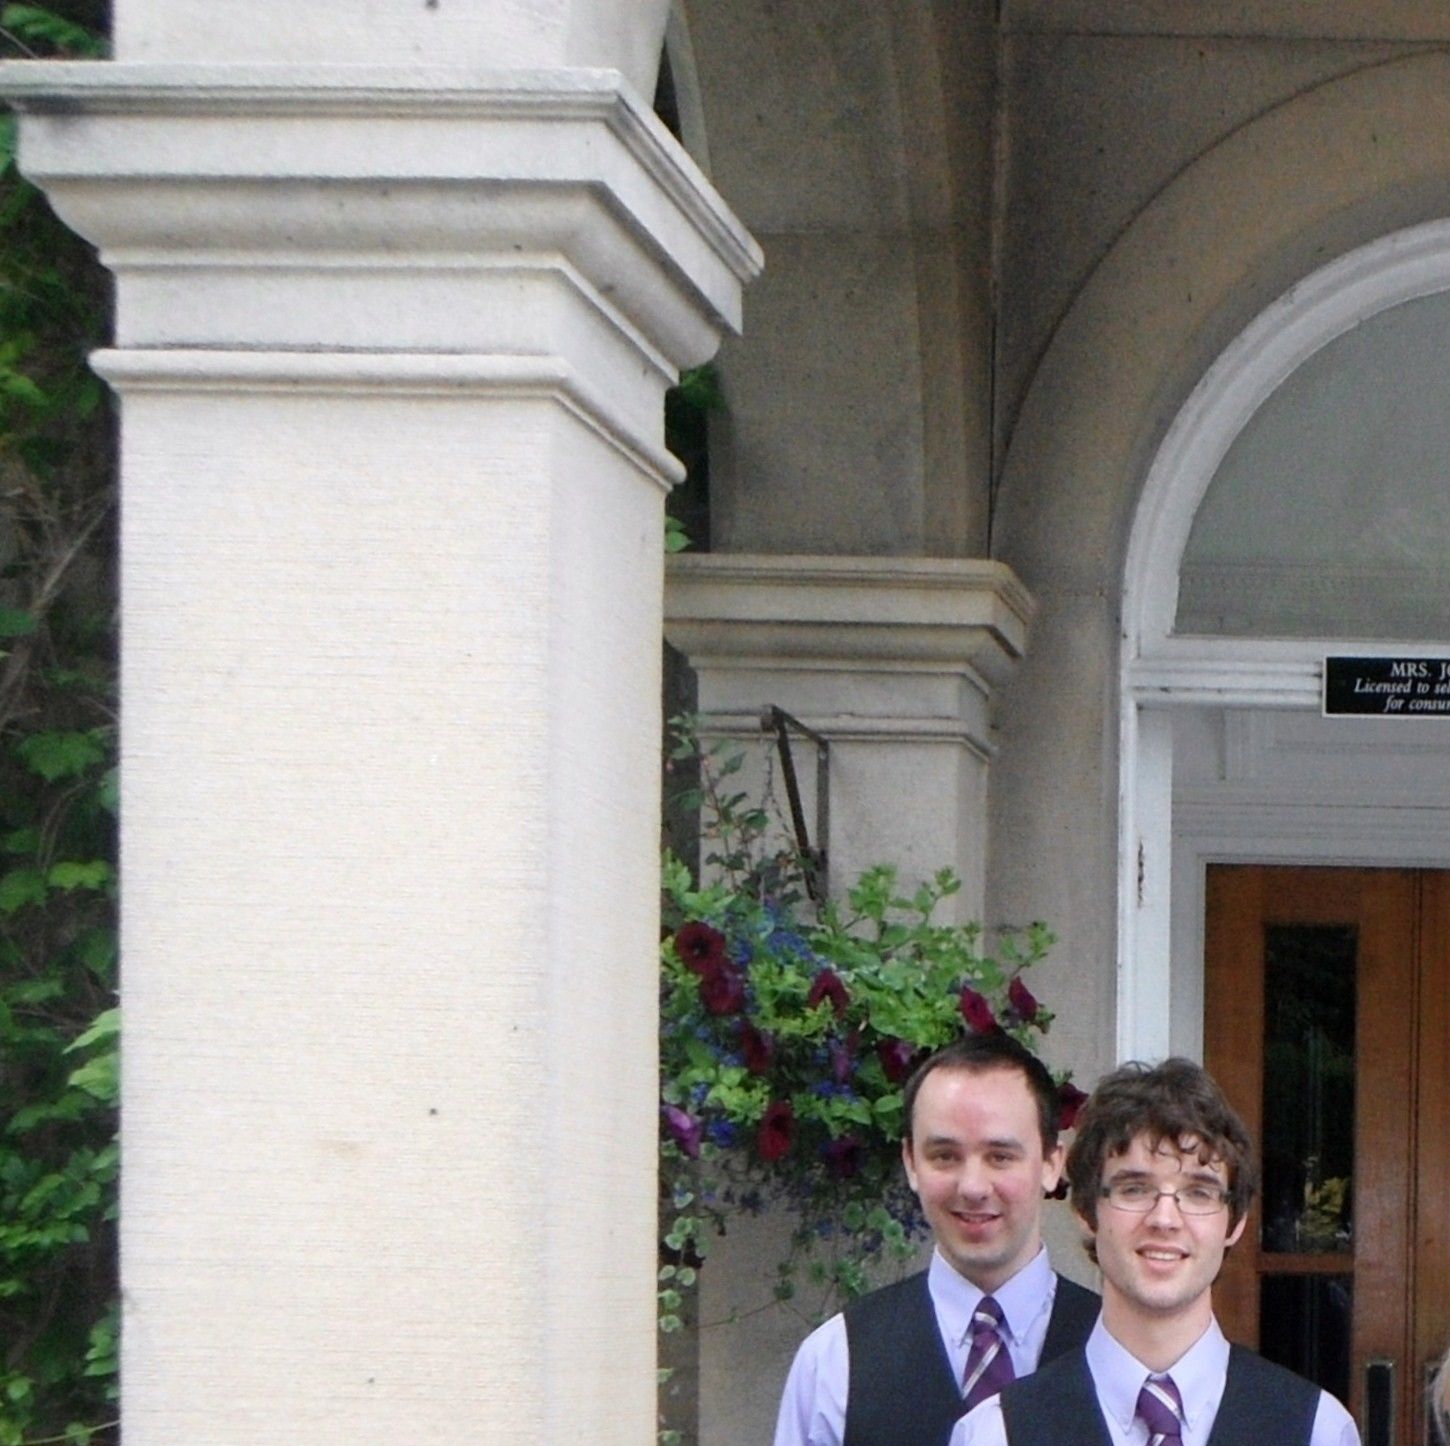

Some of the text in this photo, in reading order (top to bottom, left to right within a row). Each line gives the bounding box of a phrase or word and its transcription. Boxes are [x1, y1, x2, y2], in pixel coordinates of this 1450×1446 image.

[1391, 662, 1431, 678] MRS.
[1354, 678, 1412, 693] Licensed
[1417, 680, 1429, 694] to
[1384, 695, 1405, 712] for
